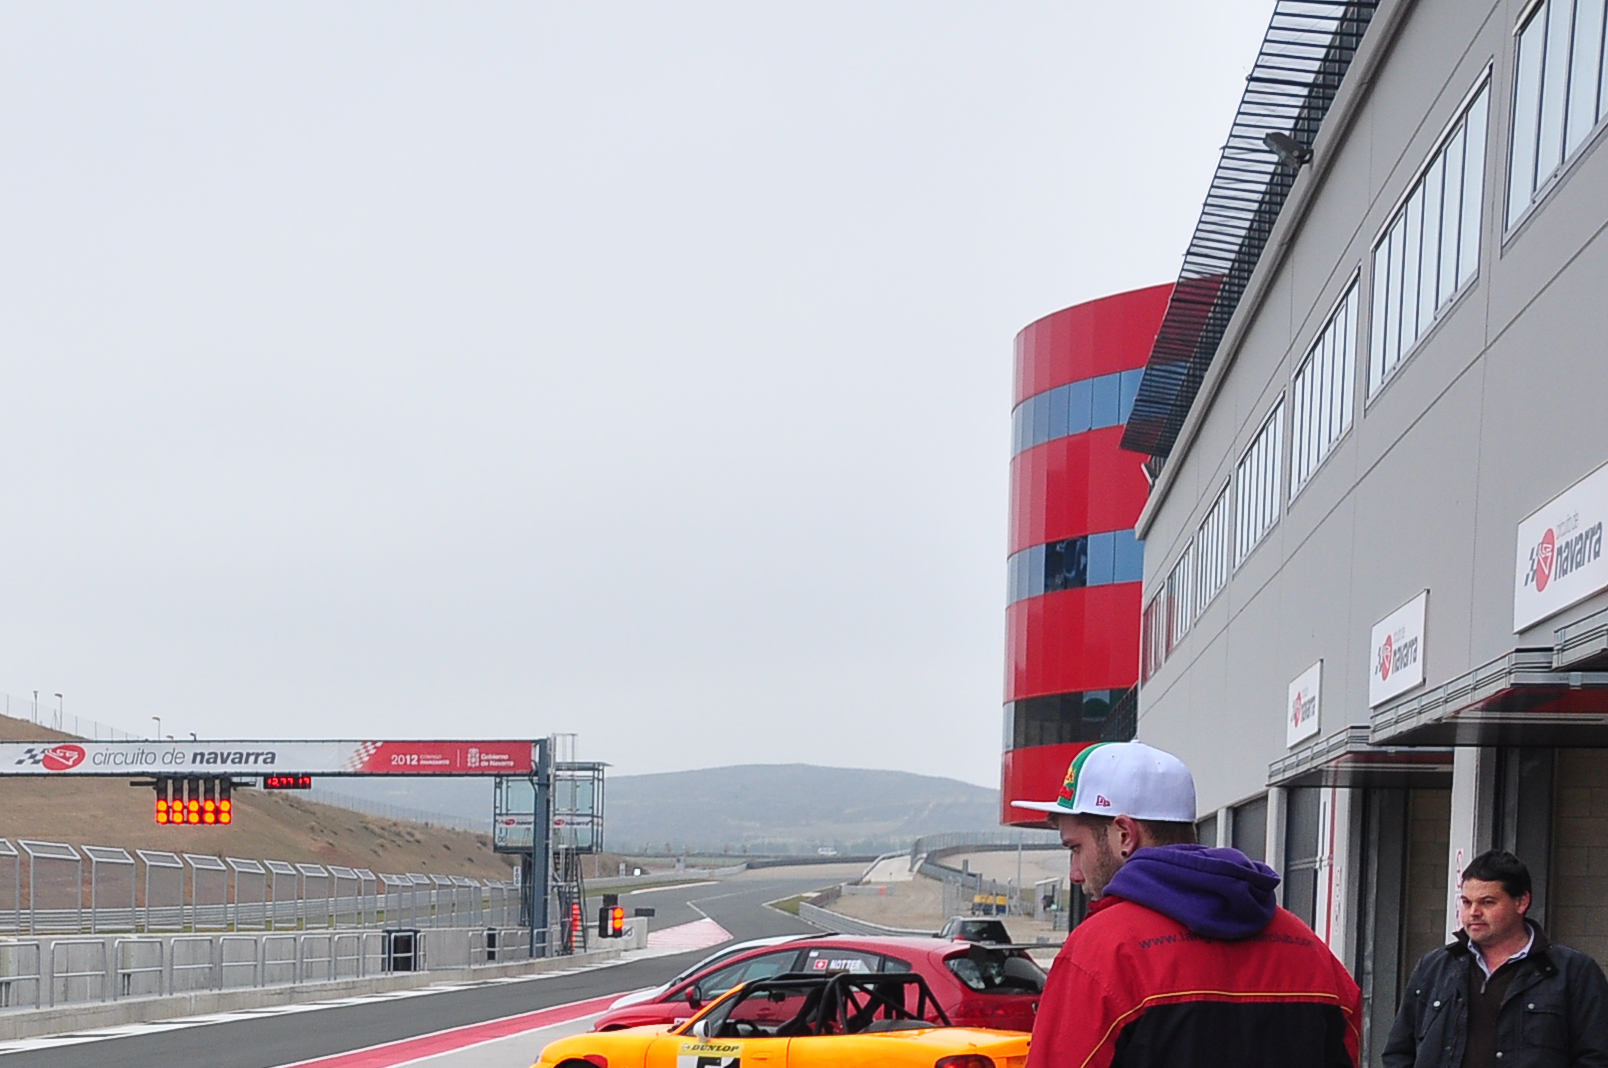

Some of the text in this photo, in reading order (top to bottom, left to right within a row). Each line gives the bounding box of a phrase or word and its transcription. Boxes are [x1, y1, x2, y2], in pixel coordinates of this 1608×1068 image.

[1554, 521, 1602, 581] navarra
[1392, 636, 1418, 675] navarra
[92, 747, 277, 766] circuito de navarra
[391, 754, 418, 766] 2012
[691, 1044, 740, 1053] DUNLOP
